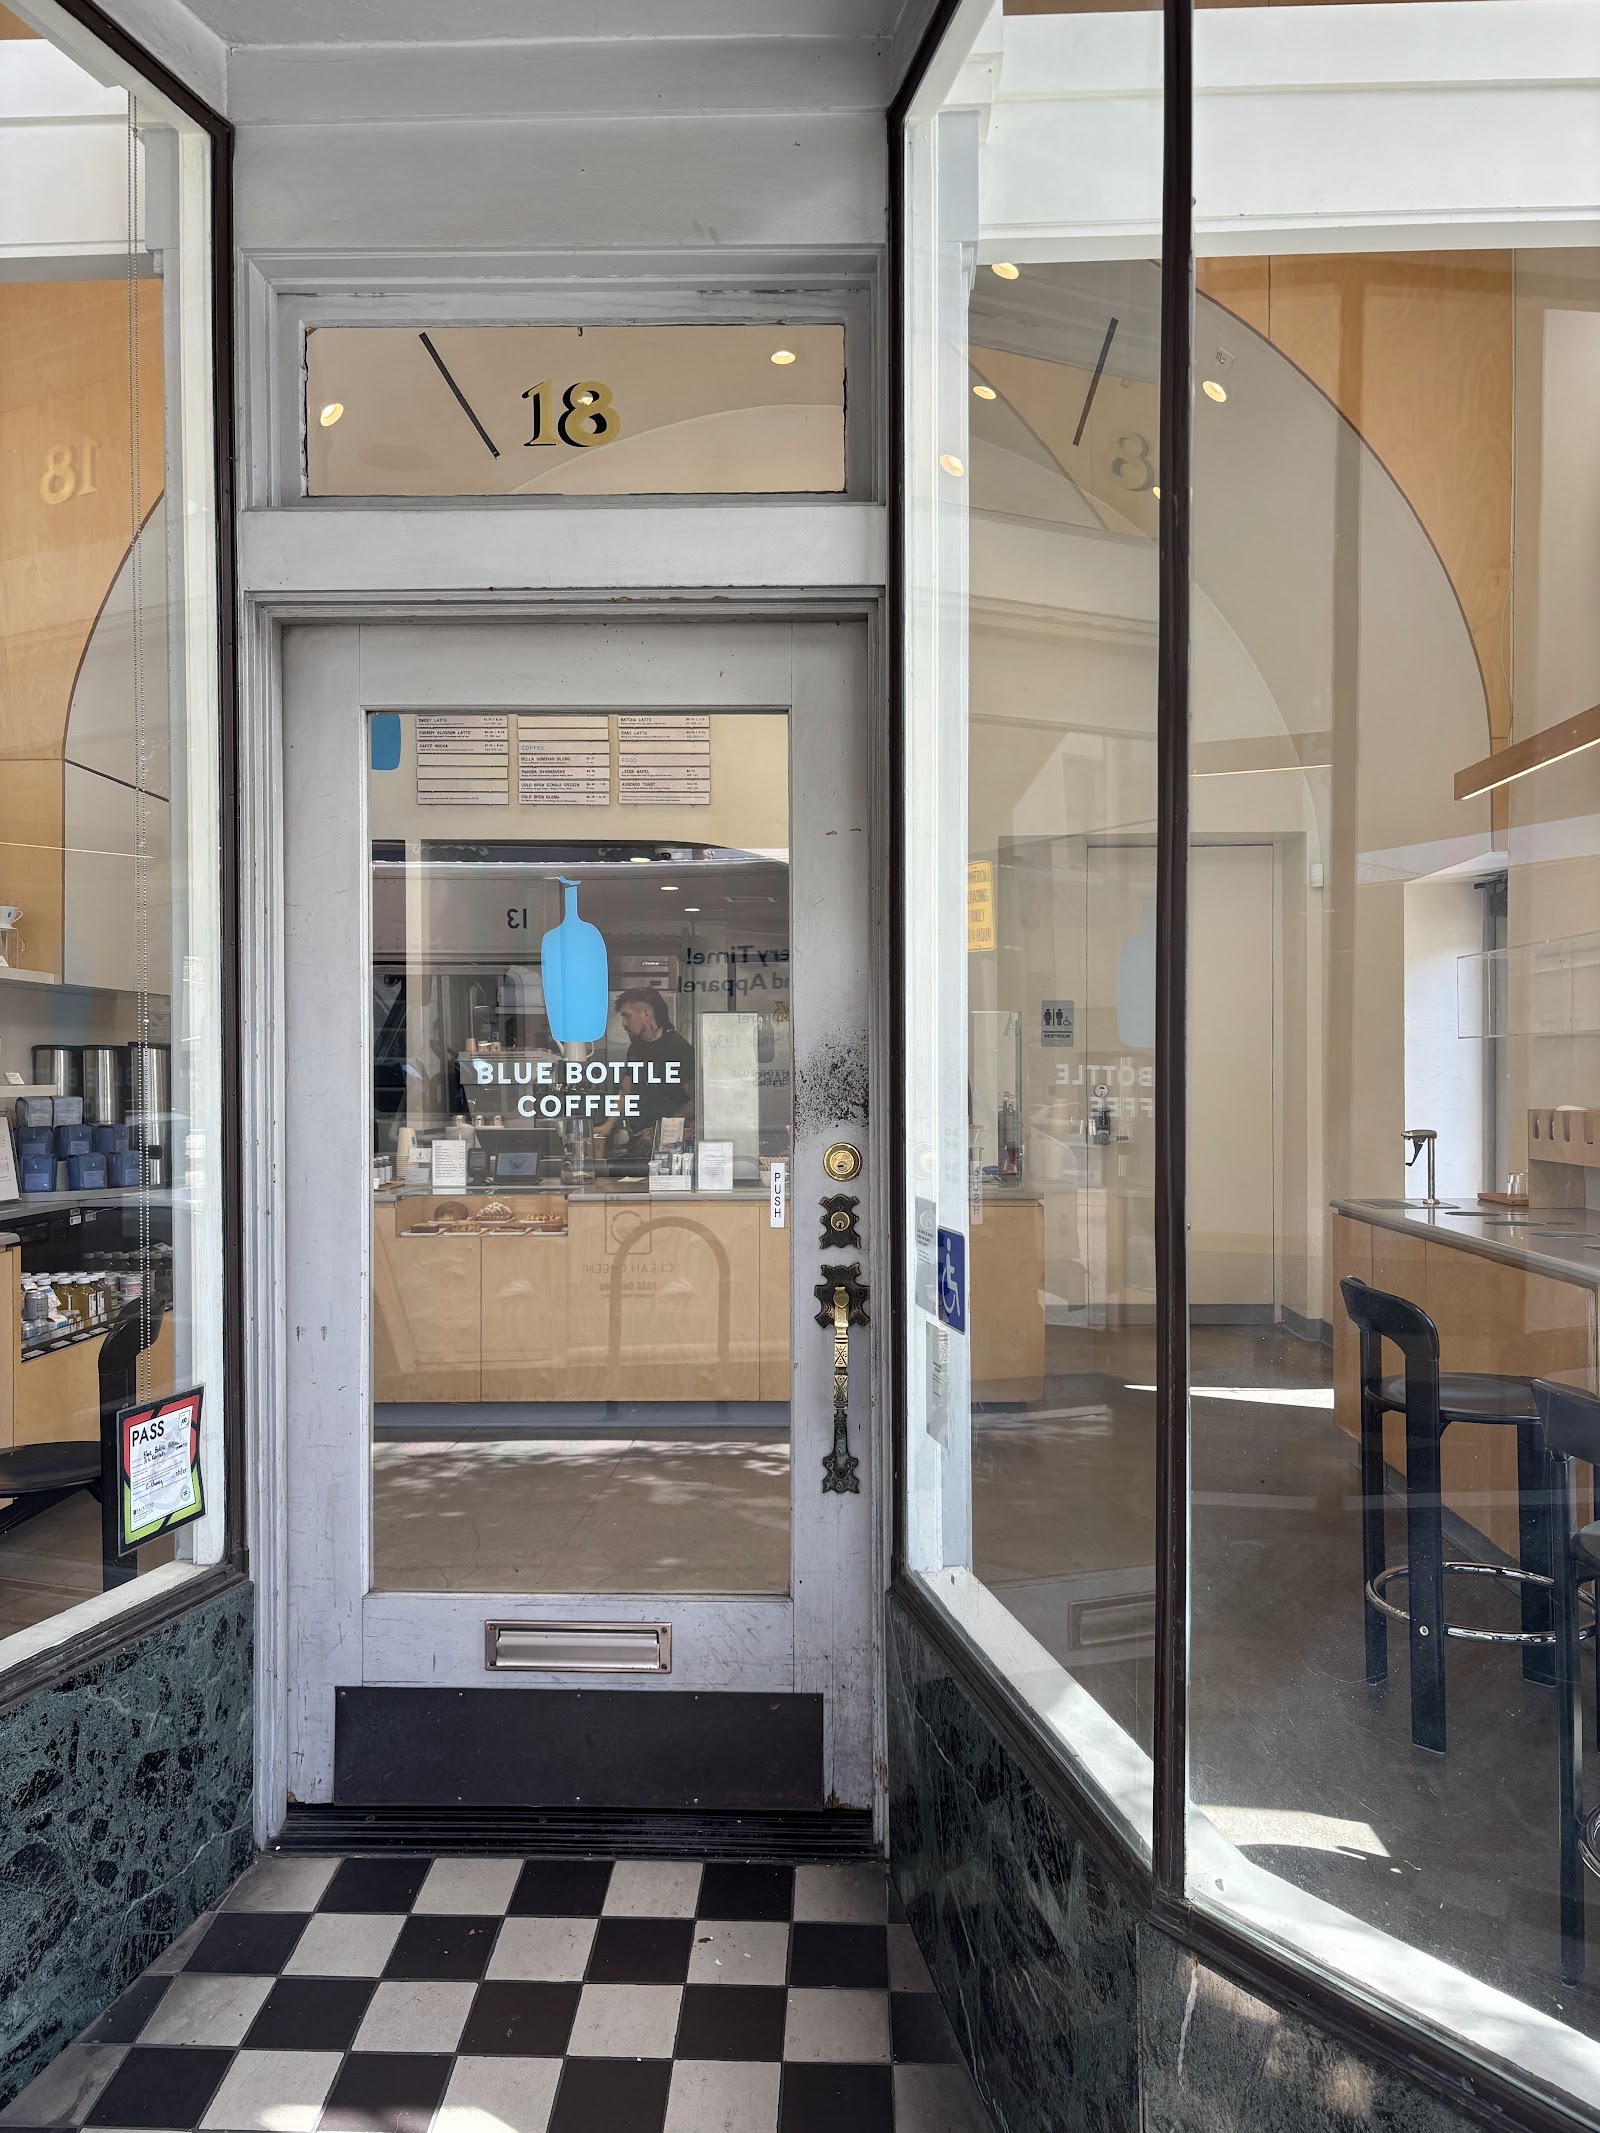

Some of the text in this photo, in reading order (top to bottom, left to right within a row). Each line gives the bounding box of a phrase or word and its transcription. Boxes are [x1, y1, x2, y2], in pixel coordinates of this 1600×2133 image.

[522, 380, 620, 447] 18
[477, 1061, 681, 1085] BLUE BOTTLE
[517, 1094, 641, 1118] COFFEE
[132, 1420, 165, 1447] PASS
